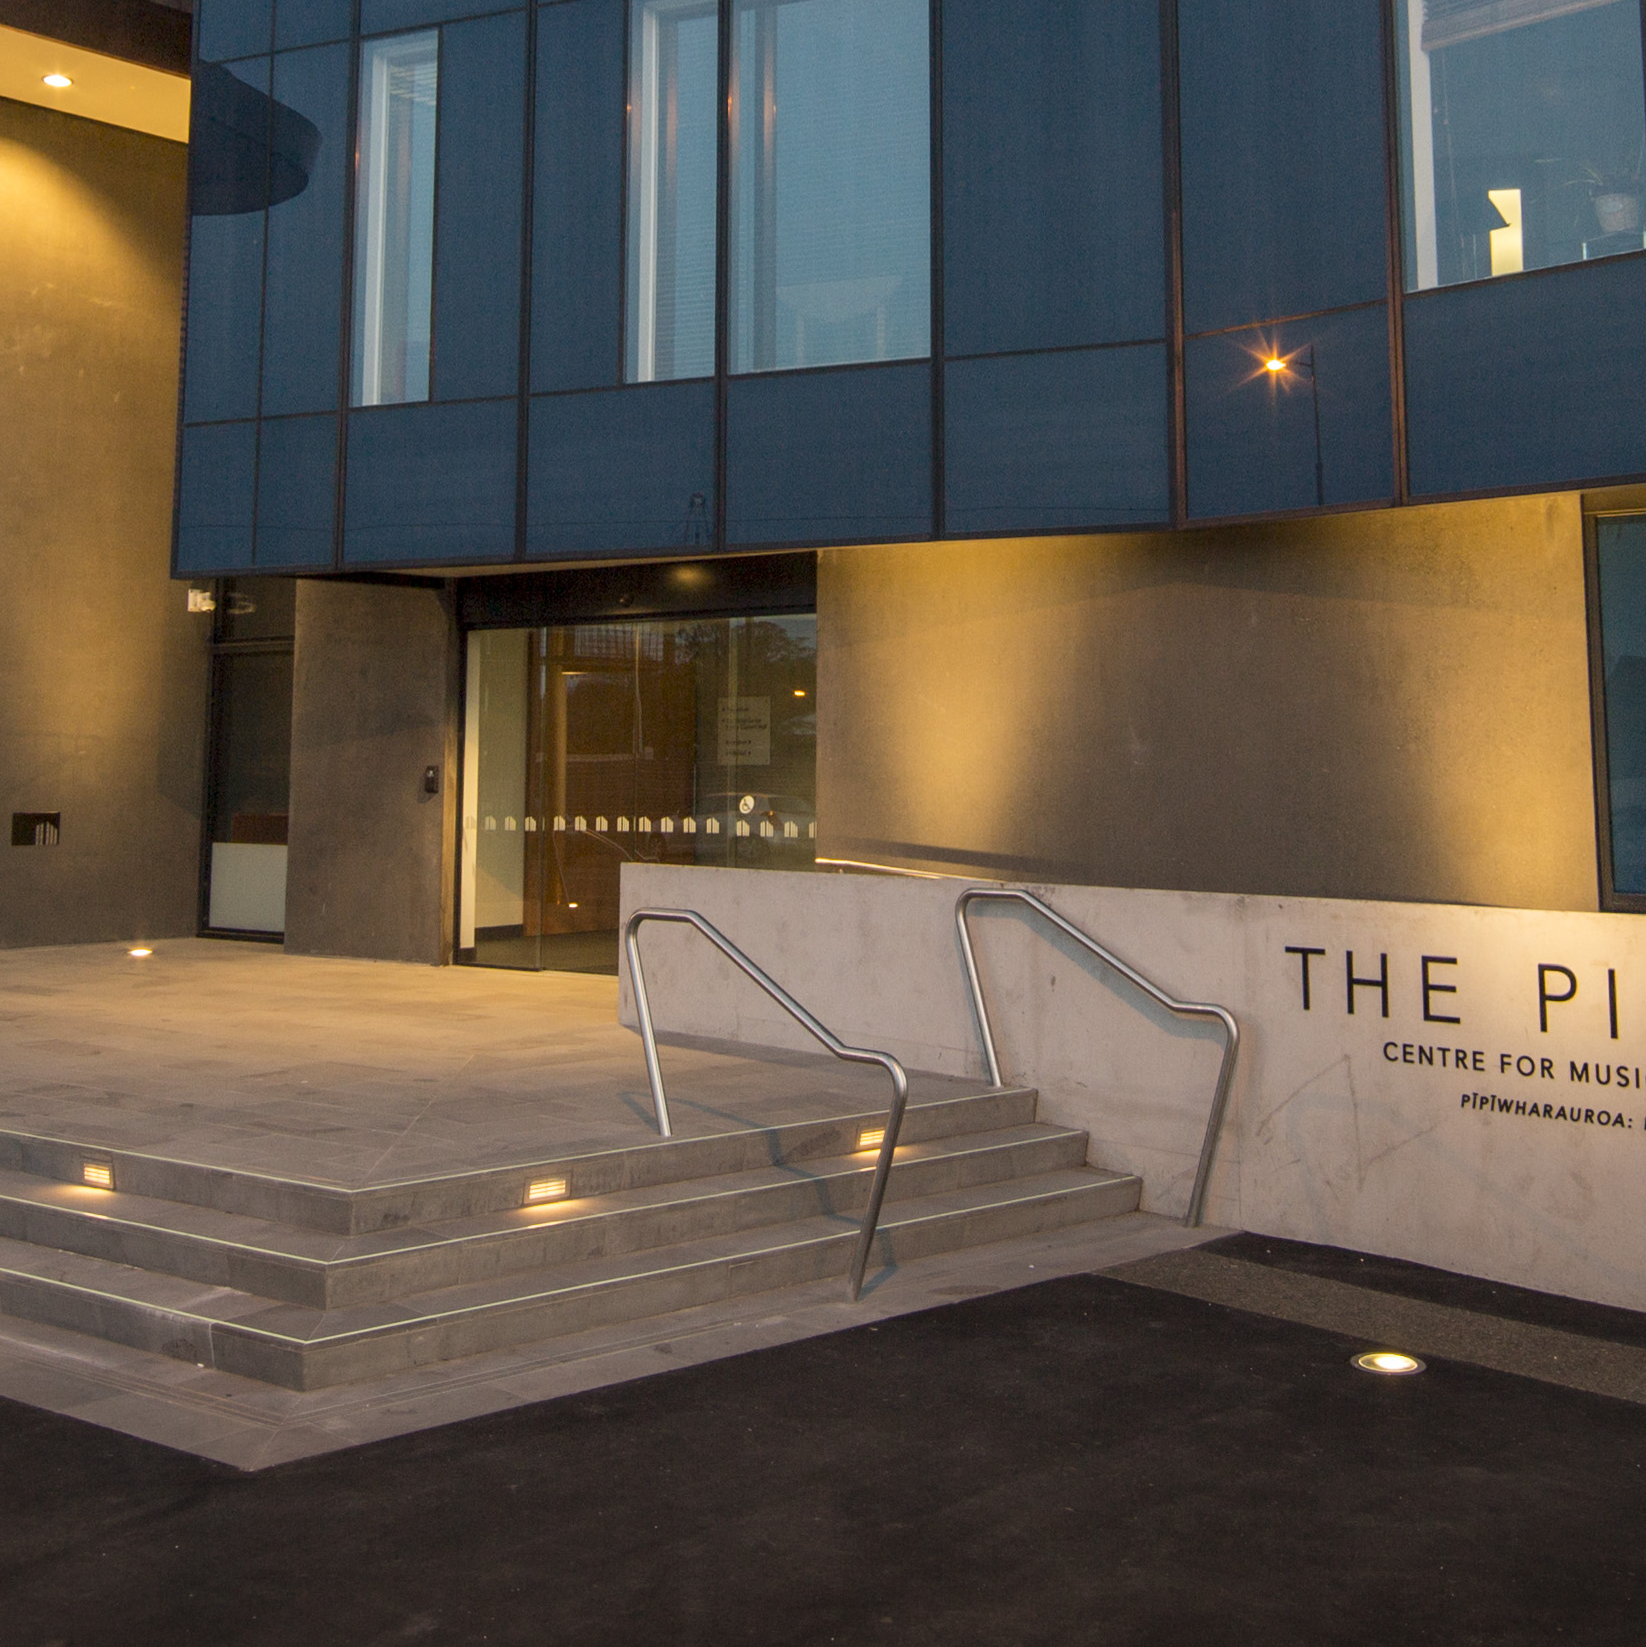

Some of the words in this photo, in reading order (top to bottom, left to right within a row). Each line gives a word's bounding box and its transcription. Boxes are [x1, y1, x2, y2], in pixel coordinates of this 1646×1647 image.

[1284, 946, 1462, 1025] THE
[1383, 1041, 1486, 1072] CENTRE
[1500, 1053, 1555, 1080] FOR
